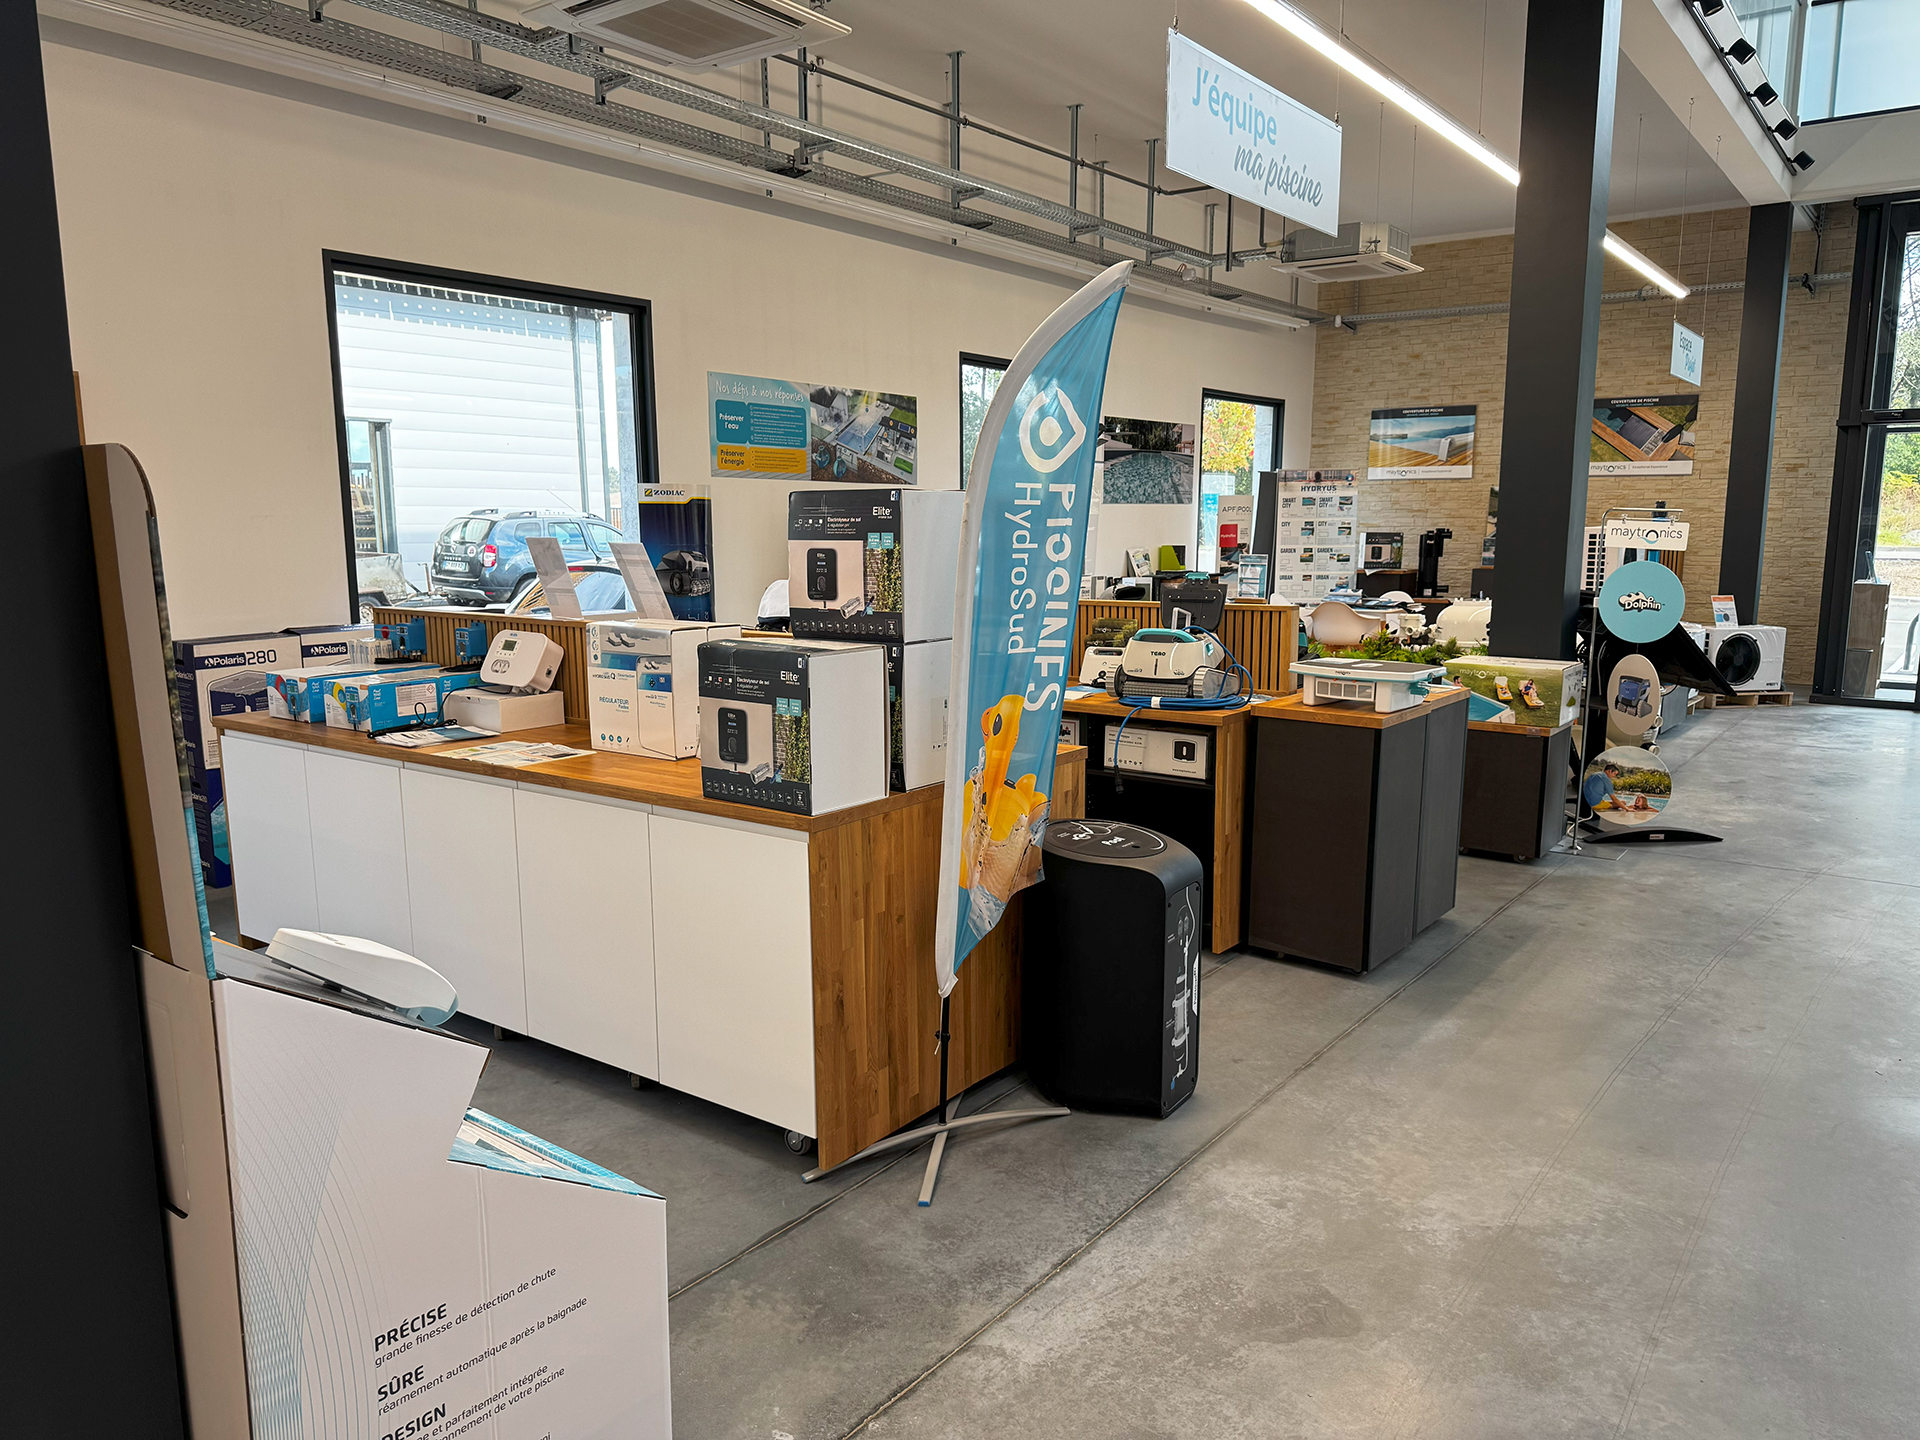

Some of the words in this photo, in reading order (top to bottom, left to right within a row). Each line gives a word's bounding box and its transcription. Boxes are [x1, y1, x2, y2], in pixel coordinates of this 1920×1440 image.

[1234, 145, 1266, 181] ma
[1264, 154, 1323, 207] piscine
[715, 381, 730, 394] Nos
[732, 381, 749, 399] défis
[760, 389, 773, 399] nos
[774, 386, 804, 404] réponses
[719, 412, 744, 422] Préserver
[720, 449, 745, 457] Préserver
[872, 506, 891, 516] Elite
[1610, 526, 1683, 544] maytronics
[1004, 482, 1043, 655] HydroSud
[1624, 597, 1661, 611] Dolphin
[214, 655, 244, 666] Polaris
[246, 649, 277, 665] 280
[318, 643, 347, 655] Polaris
[780, 670, 799, 682] Elite
[374, 1302, 447, 1353] PRÉCISE
[375, 1341, 413, 1368] grande
[415, 1321, 453, 1346] finesse
[455, 1312, 468, 1325] de
[470, 1289, 515, 1318] détection
[517, 1282, 529, 1294] de
[531, 1267, 557, 1287] chute
[378, 1374, 444, 1417] réarmement
[446, 1340, 508, 1380] automatique
[509, 1326, 535, 1346] après
[537, 1319, 545, 1330] la
[547, 1297, 588, 1325] baignade
[378, 1365, 425, 1402] SÛRE
[432, 1423, 443, 1435] et
[445, 1386, 508, 1430] parfaitement
[510, 1365, 548, 1392] intégrée
[436, 1411, 493, 1440] onnement
[494, 1402, 507, 1414] de
[508, 1388, 533, 1407] votre
[534, 1367, 566, 1393] piscine
[381, 1403, 447, 1440] DESIGN
